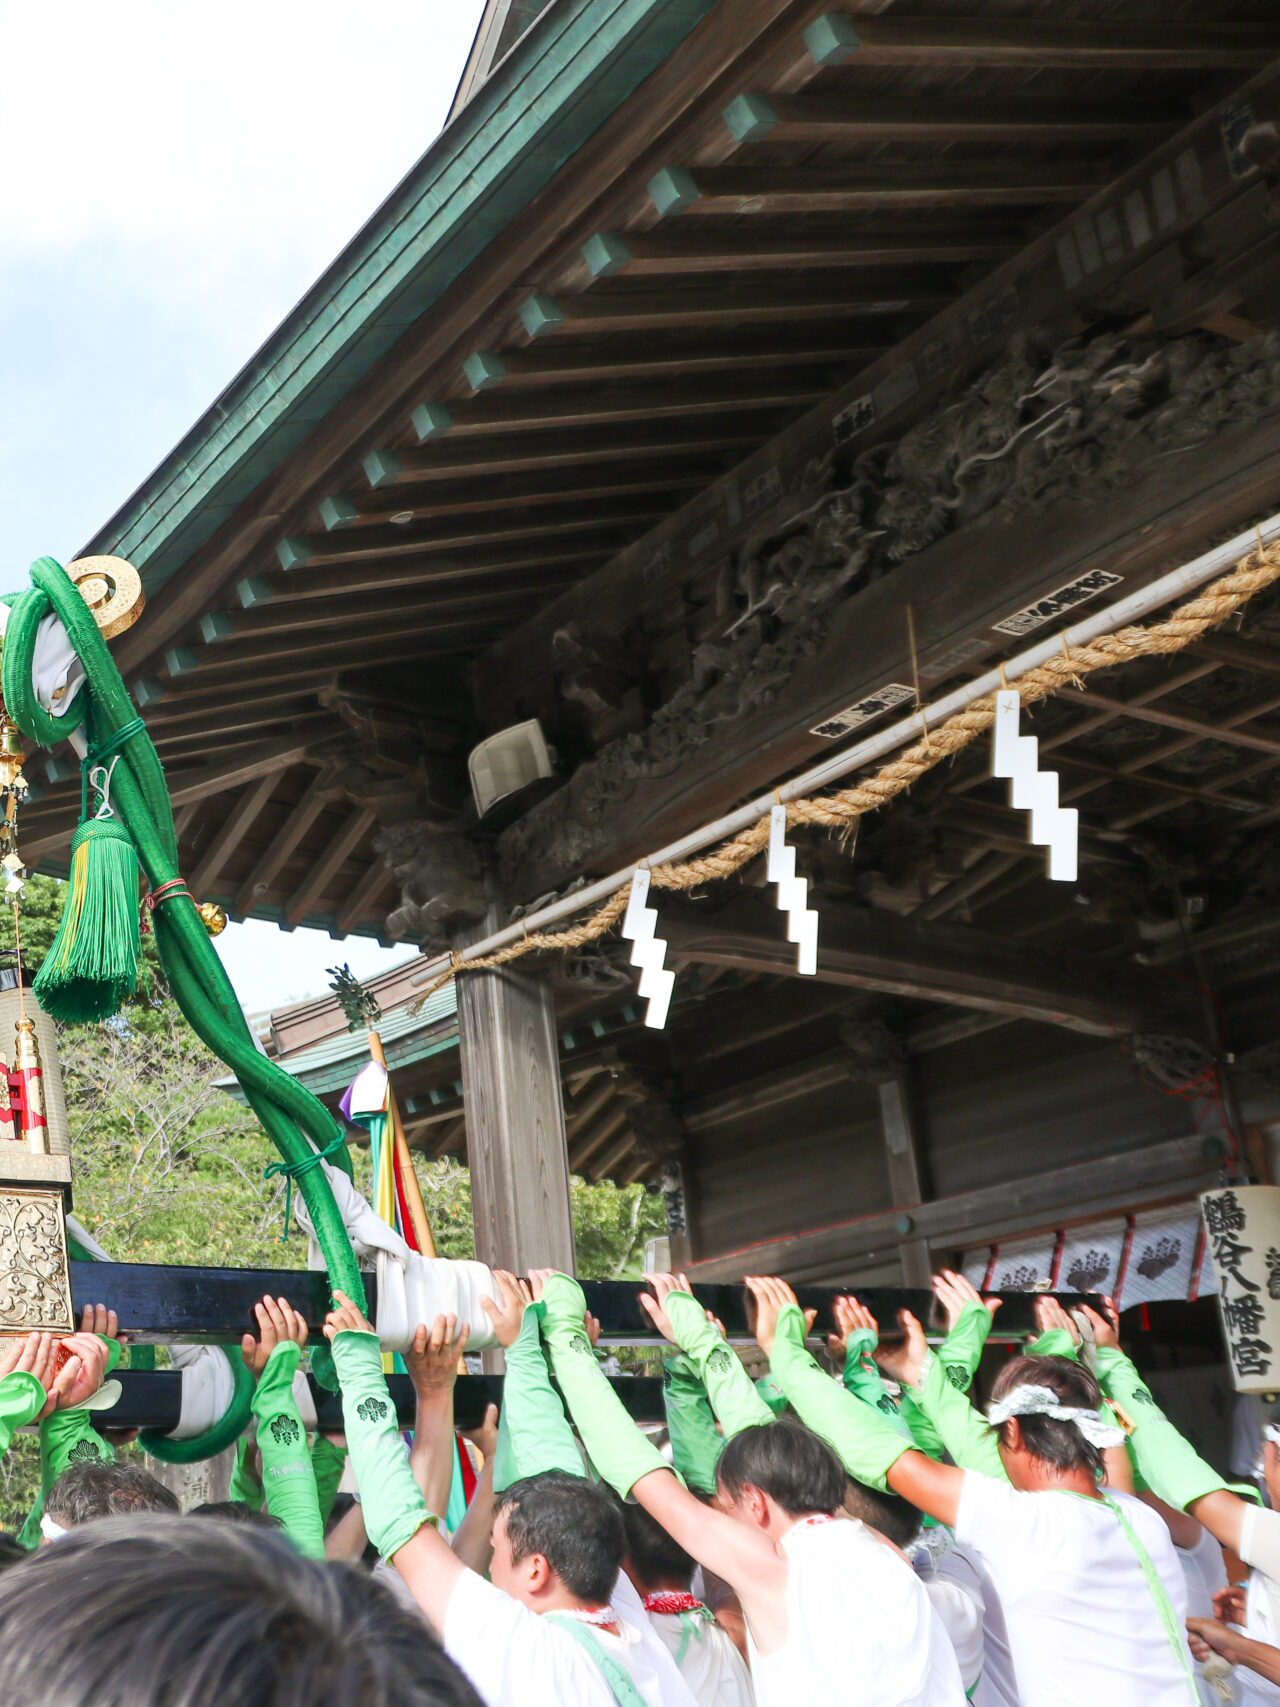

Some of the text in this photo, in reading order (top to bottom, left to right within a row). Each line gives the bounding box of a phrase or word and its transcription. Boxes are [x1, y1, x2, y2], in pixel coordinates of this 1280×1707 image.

[1204, 1191, 1272, 1377] 鶴谷八幡宮
